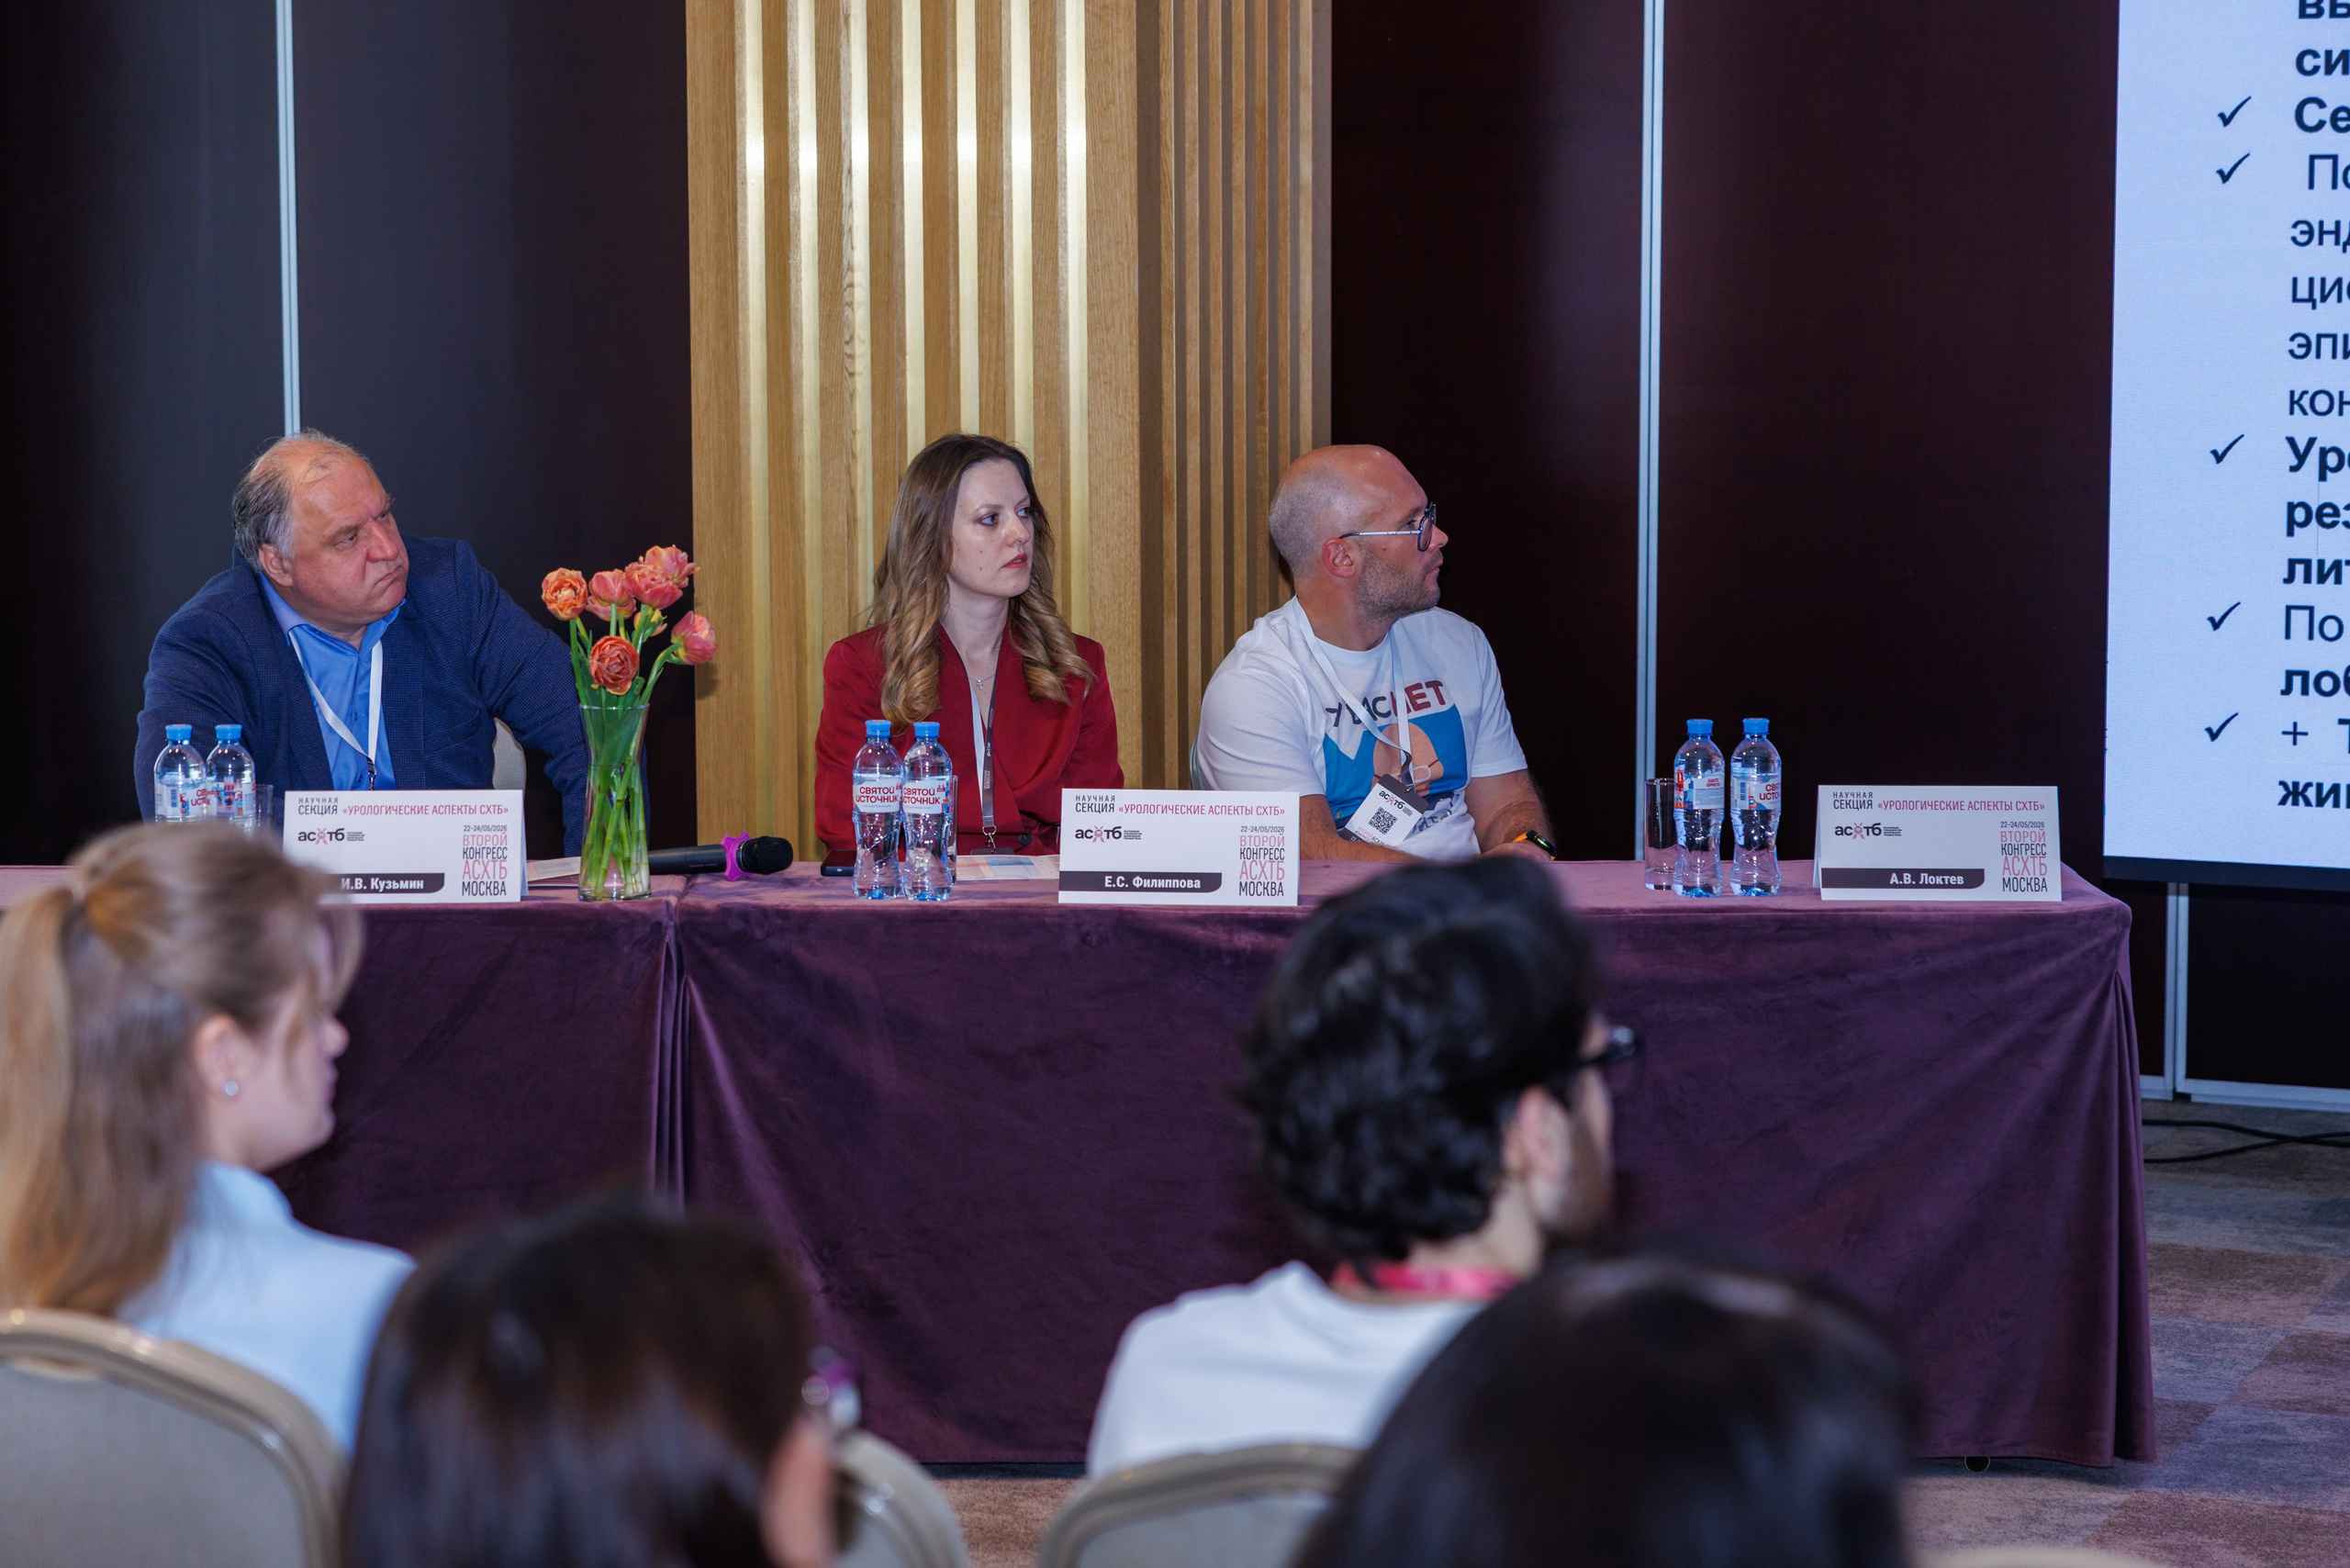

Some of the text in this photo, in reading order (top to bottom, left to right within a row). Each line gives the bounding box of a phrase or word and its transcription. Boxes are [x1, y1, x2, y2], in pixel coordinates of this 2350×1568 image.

[2296, 49, 2350, 76] си
[2295, 96, 2350, 133] Се
[2290, 219, 2350, 253] эн
[2291, 276, 2350, 310] ци
[2285, 435, 2350, 482] Ур
[2282, 557, 2350, 585] ли
[2285, 604, 2344, 642] По
[859, 786, 895, 794] СВЯТОЙ
[2277, 780, 2350, 810] жи
[1075, 794, 1115, 802] НАУЧНАЯ
[1832, 799, 2045, 811] СЕКЦИЯ «УРОЛОГИЧЕСКИЕ АСПЕКТЫ СХТБ»
[297, 804, 509, 816] СЕКЦИЯ «УРОЛОГИЧЕСКИЕ АСПЕКТЫ СХТБ»
[1075, 802, 1285, 816] СЕКЦИЯ «УРОЛОГИЧЕСКИЕ АСПЕКТЫ СХТБ»
[463, 824, 508, 833] 22-24/05/2026
[1240, 825, 1285, 834] 22-24/05/2026
[463, 833, 508, 846] ВТОРОЙ
[1239, 834, 1285, 847] ВТОРОЙ
[2000, 829, 2046, 843] ВТОРОЙ
[462, 846, 508, 860] КОНГРЕСС
[1239, 847, 1285, 860] КОНГРЕСС
[2001, 843, 2047, 856] КОНГРЕСС
[462, 859, 508, 880] АСХТБ
[1239, 860, 1285, 880] АСХТБ
[2002, 856, 2048, 876] АСХТБ
[341, 878, 424, 892] И.В. Кузьмин
[1104, 875, 1201, 890] Е.С. Филиппова
[1889, 872, 1964, 885] А.В. Локтев
[2002, 877, 2048, 892] МОСКВА
[462, 881, 507, 896] МОСКВА
[1238, 881, 1284, 897] МОСКВА
